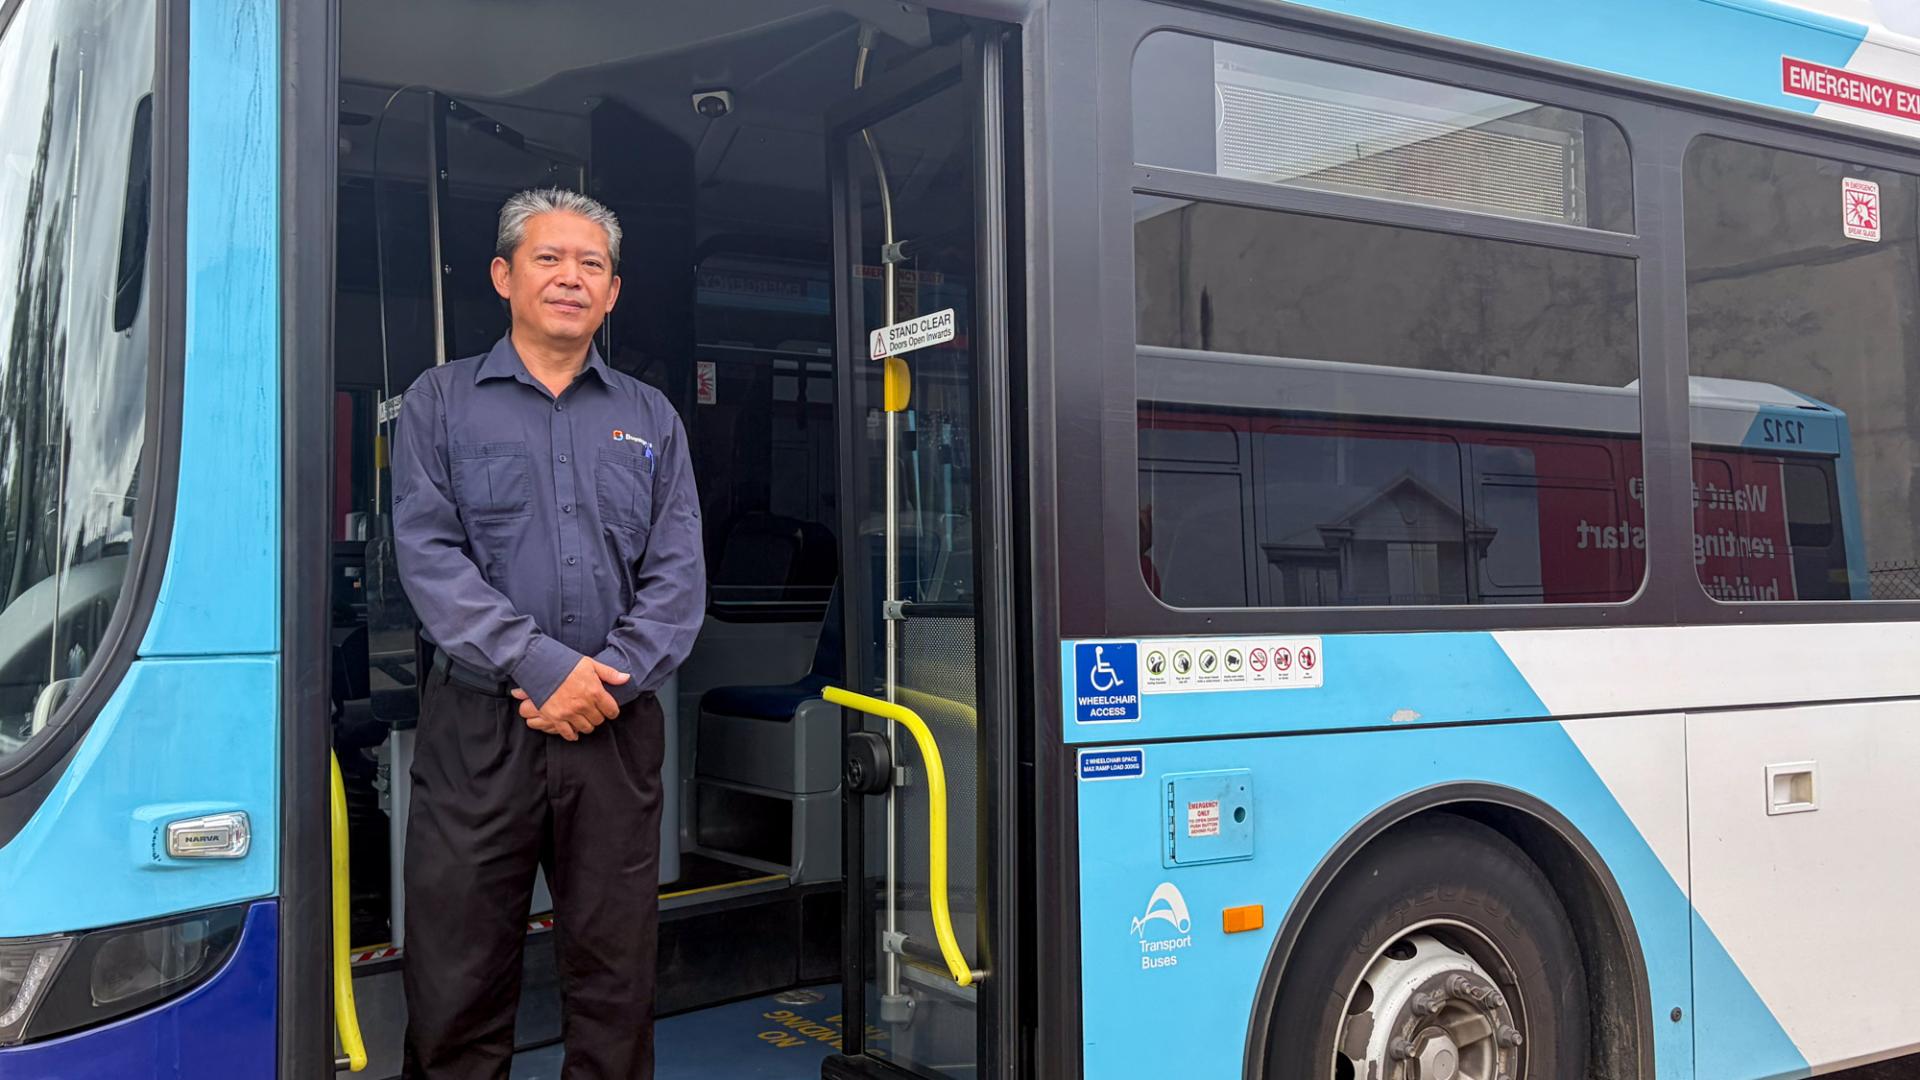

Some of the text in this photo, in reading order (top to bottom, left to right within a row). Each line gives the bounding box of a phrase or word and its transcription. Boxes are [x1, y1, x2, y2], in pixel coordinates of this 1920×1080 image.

[1789, 65, 1920, 115] EMERGENCY EXI
[1850, 182, 1876, 193] EMERGENCY
[1848, 226, 1877, 238] BREAK GLASS
[889, 313, 951, 341] STAND CLEAR
[889, 328, 952, 352] Doors Open Inwards
[1078, 695, 1137, 706] WHEELCHAIR
[1090, 707, 1126, 717] ACCESS
[1089, 757, 1121, 765] WHEELCHAIR
[1188, 801, 1218, 809] EMERGENCY
[185, 835, 219, 843] NARVA
[1139, 935, 1192, 953] Transport
[1141, 955, 1178, 970] Buses
[758, 1031, 806, 1048] NO
